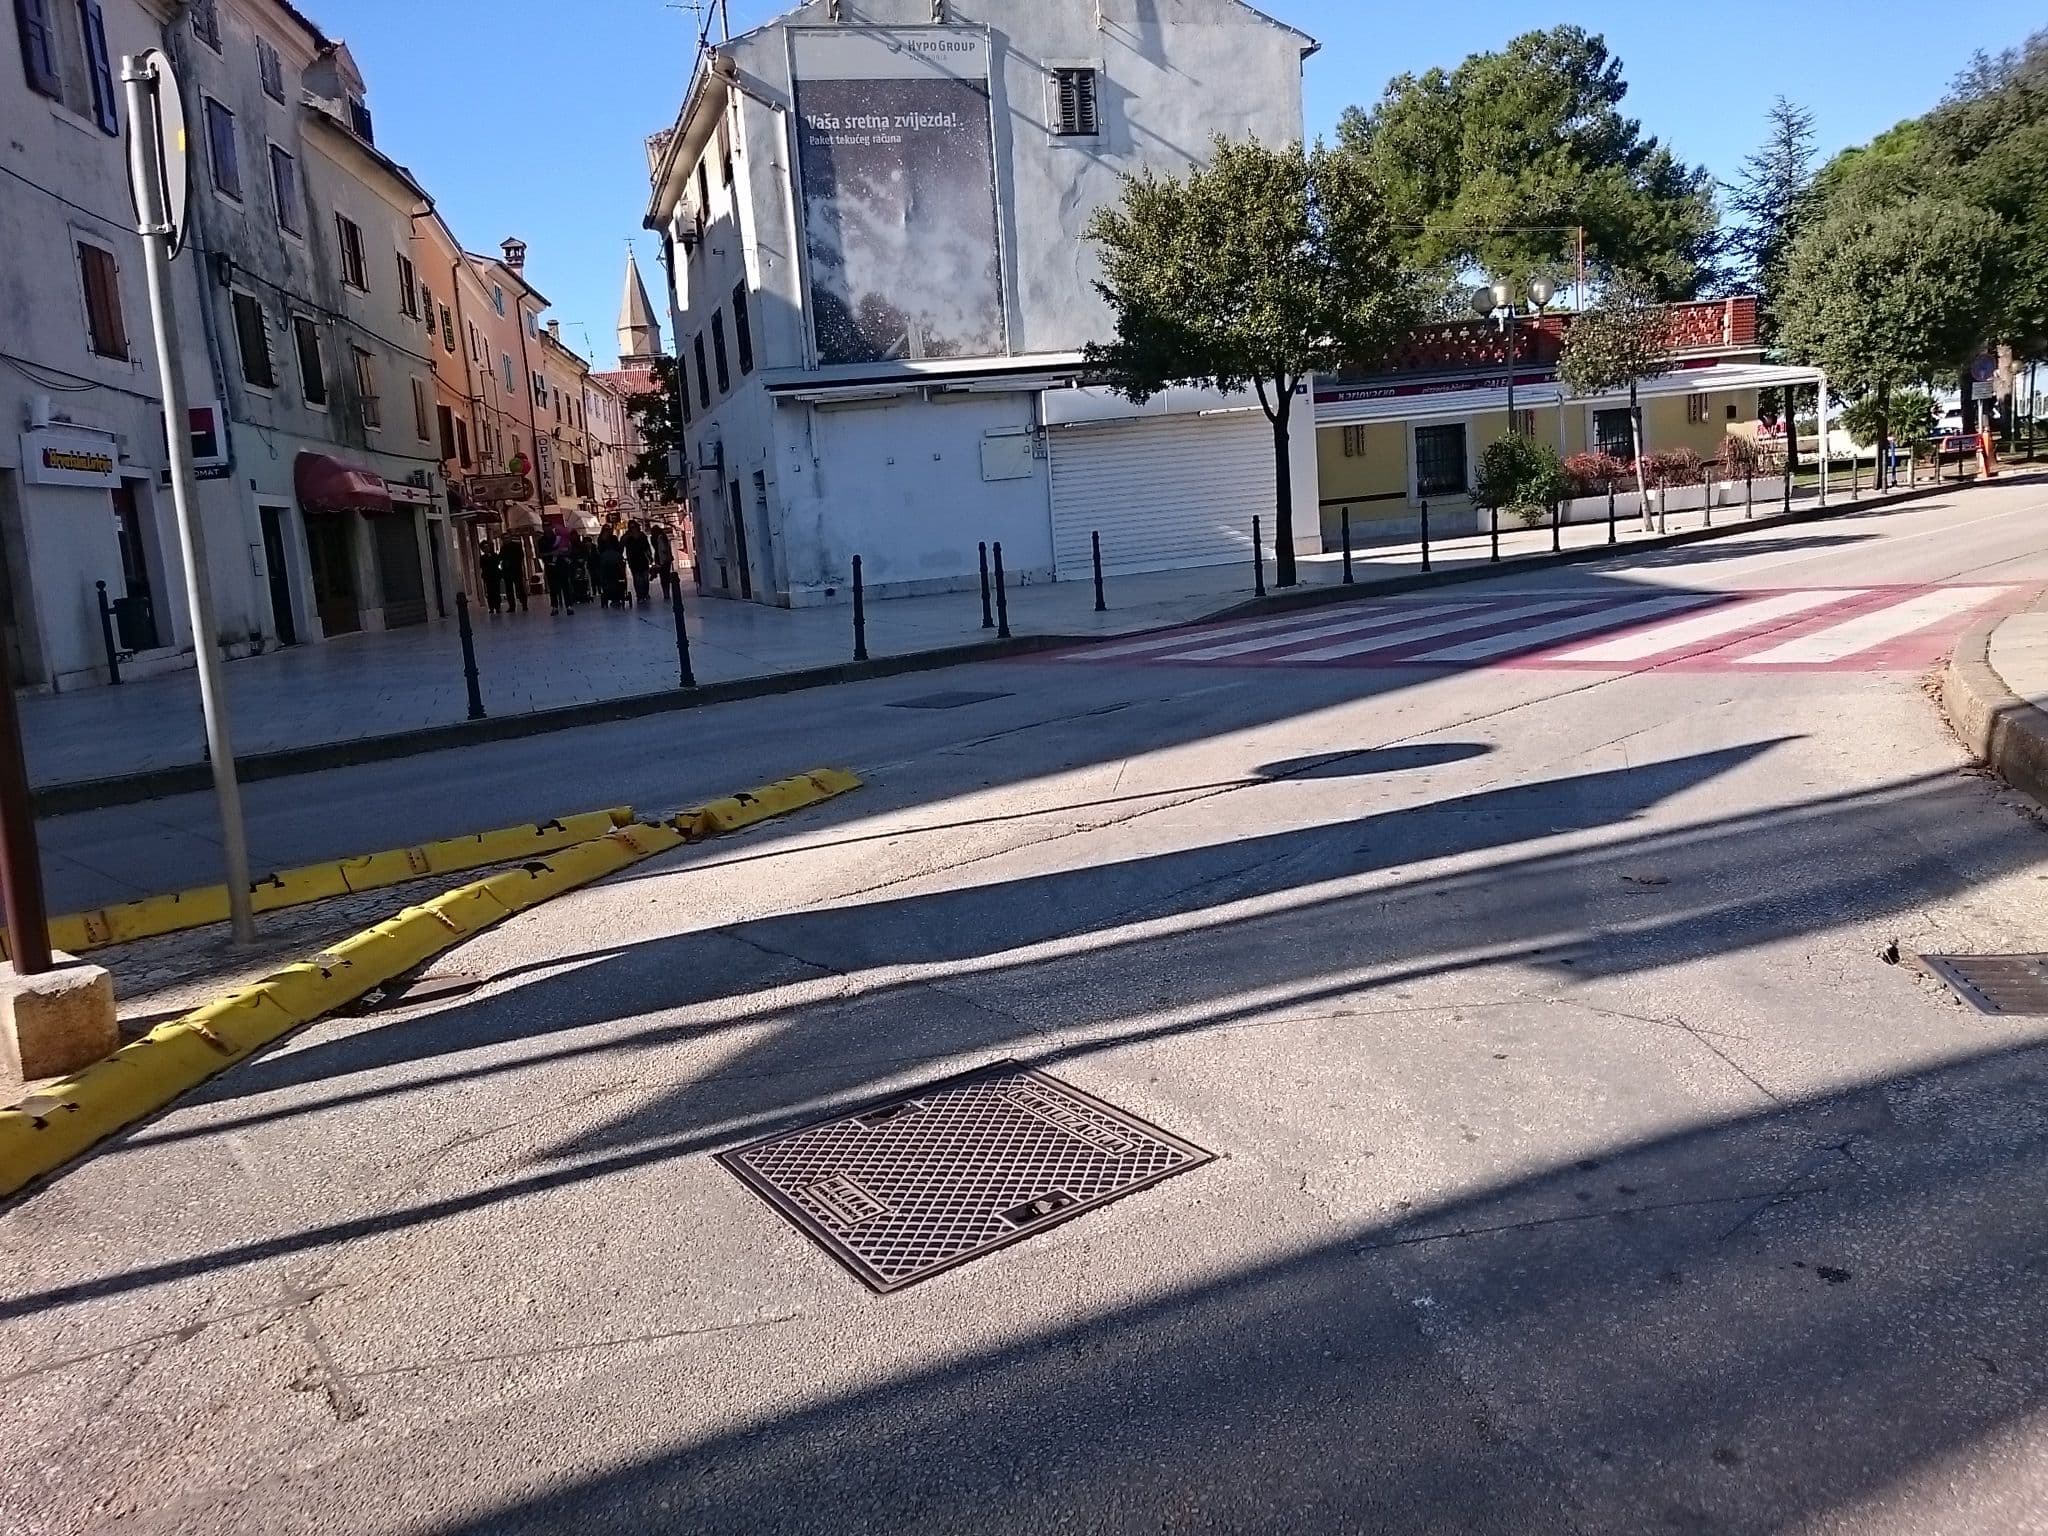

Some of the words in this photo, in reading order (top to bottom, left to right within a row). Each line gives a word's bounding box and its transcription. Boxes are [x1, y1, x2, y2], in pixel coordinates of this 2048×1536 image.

[807, 113, 840, 129] Vaša
[845, 114, 889, 128] sretna
[894, 111, 956, 131] zvijezda!
[809, 135, 833, 146] Paket
[836, 133, 871, 146] tekućeg
[873, 133, 902, 144] računa
[538, 438, 552, 488] OPTIKA
[1009, 1091, 1126, 1151] KANALIZACIJA
